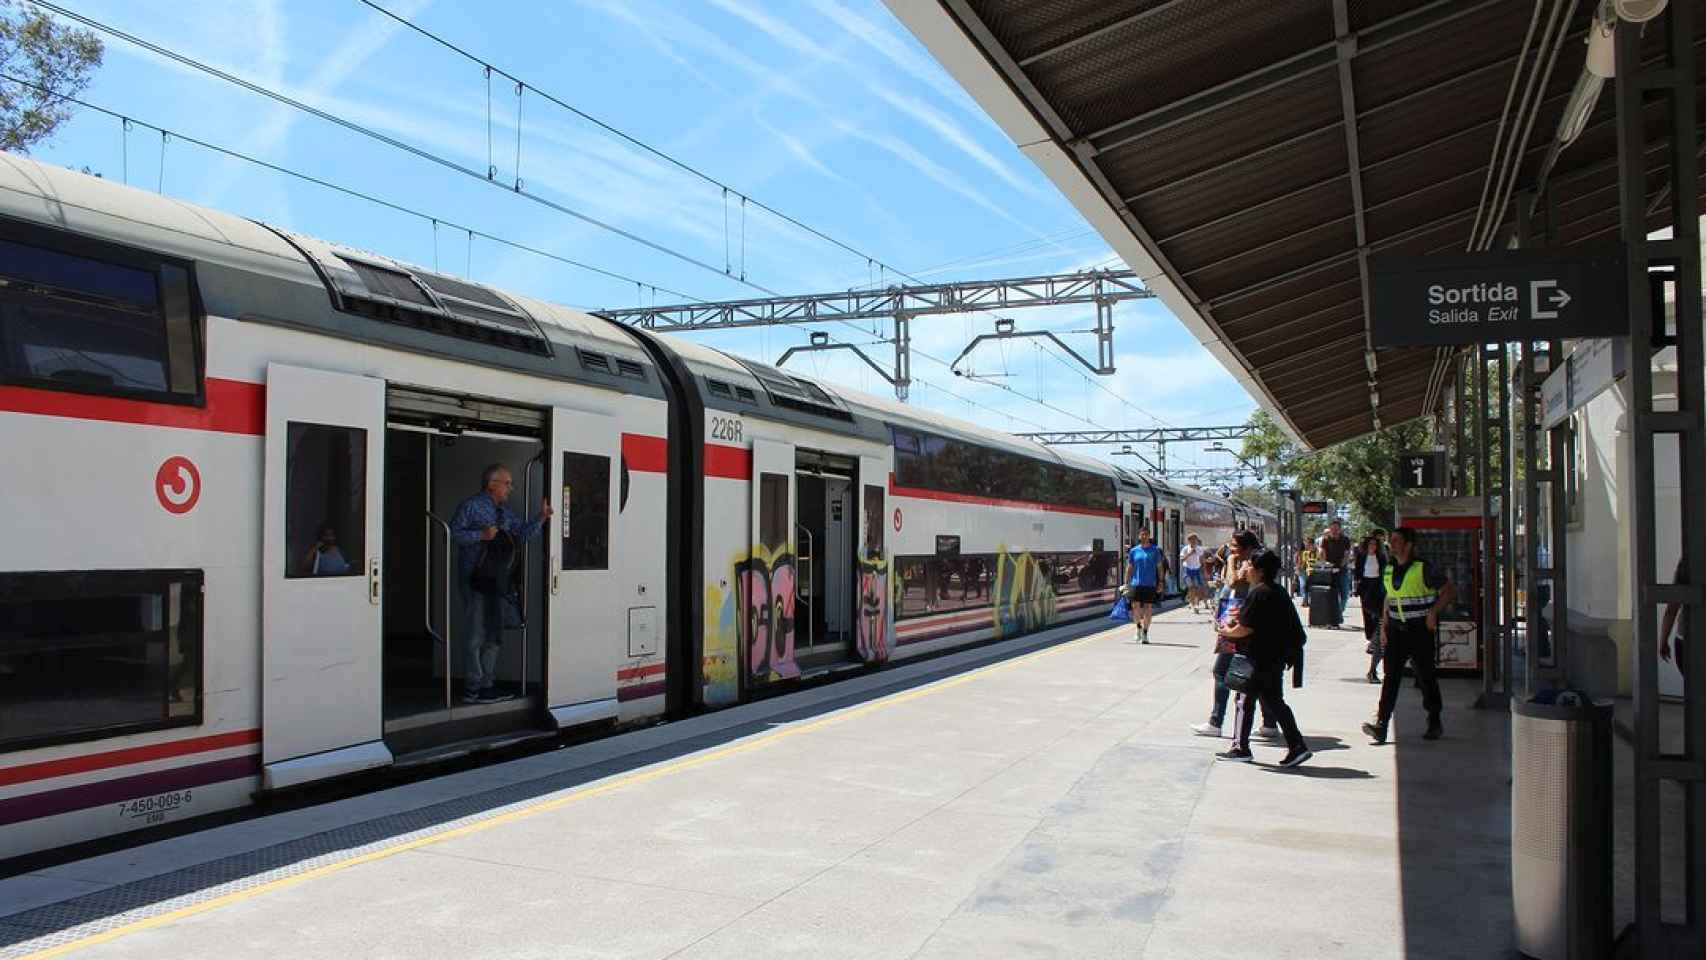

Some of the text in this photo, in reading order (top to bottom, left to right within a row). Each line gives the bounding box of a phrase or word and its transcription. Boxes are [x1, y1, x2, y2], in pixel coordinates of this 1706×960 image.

[1428, 282, 1518, 304] Sortida
[1428, 306, 1519, 324] Salida Exit
[711, 416, 743, 442] 226R
[1412, 467, 1423, 486] 1
[118, 790, 192, 816] 7-450-009-6
